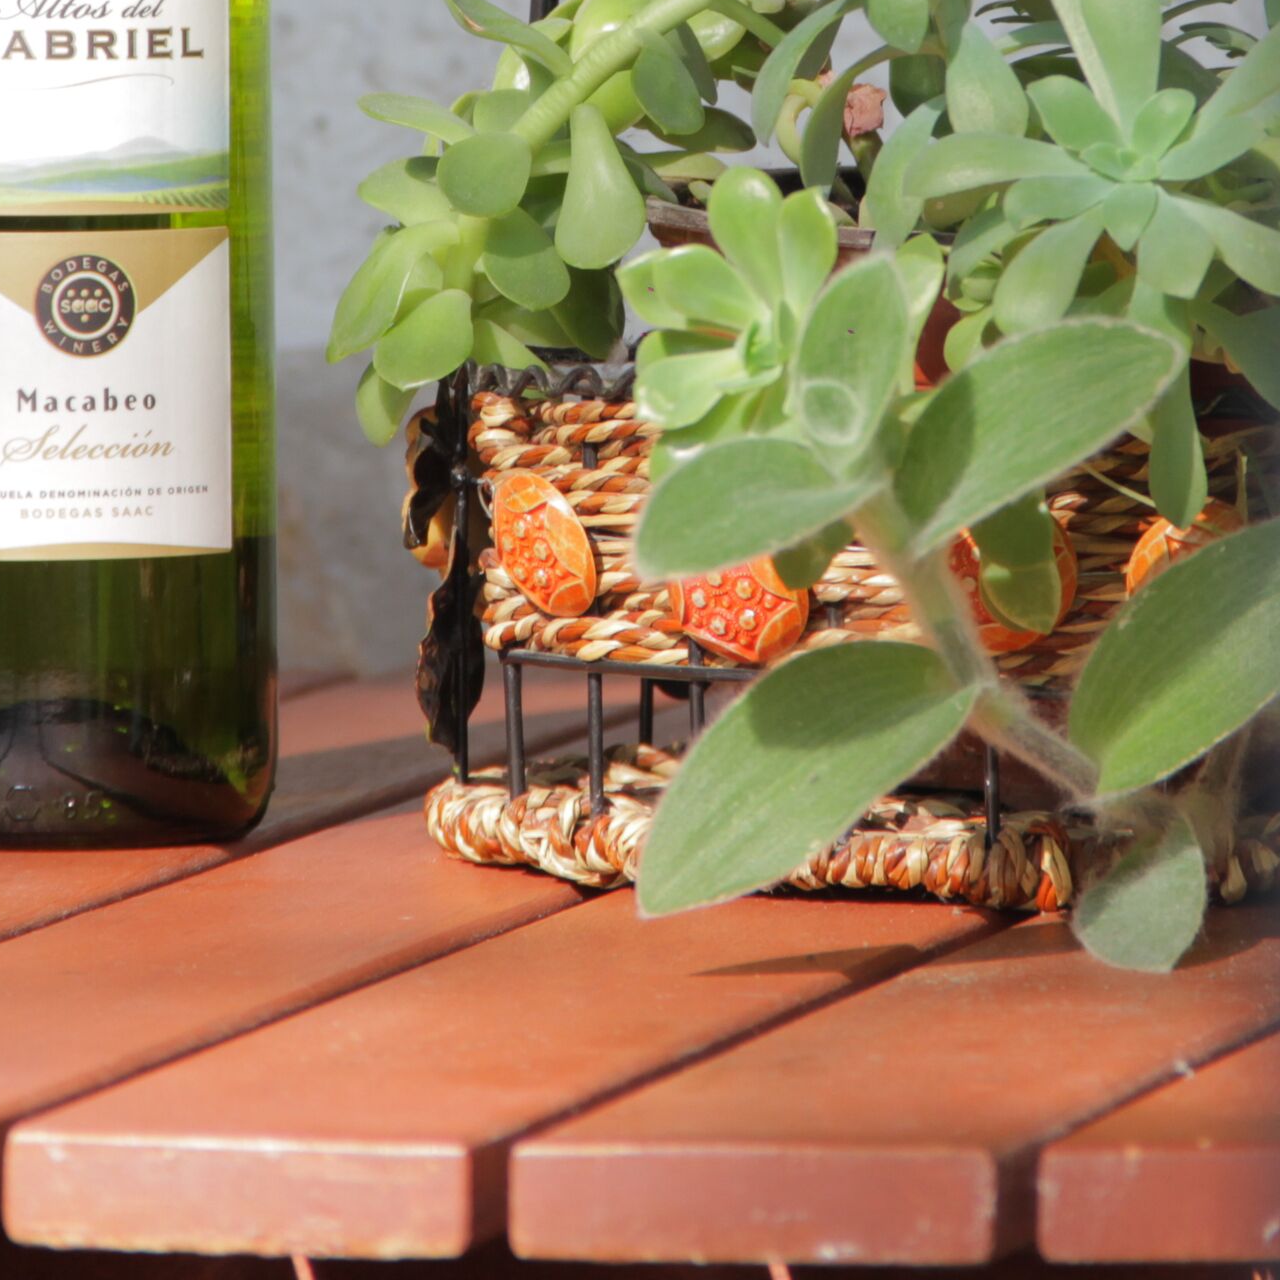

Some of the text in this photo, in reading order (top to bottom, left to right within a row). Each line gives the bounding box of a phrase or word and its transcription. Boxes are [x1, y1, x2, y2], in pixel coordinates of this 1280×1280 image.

[41, 256, 129, 294] BODEGAS
[43, 317, 128, 353] WINERY
[16, 387, 157, 413] Macabeo
[0, 423, 174, 467] Selección
[39, 486, 143, 500] DENOMINACIÓN
[147, 487, 163, 497] DE
[168, 484, 209, 496] ORIGEN
[20, 505, 154, 520] BODEGAS SAAC
